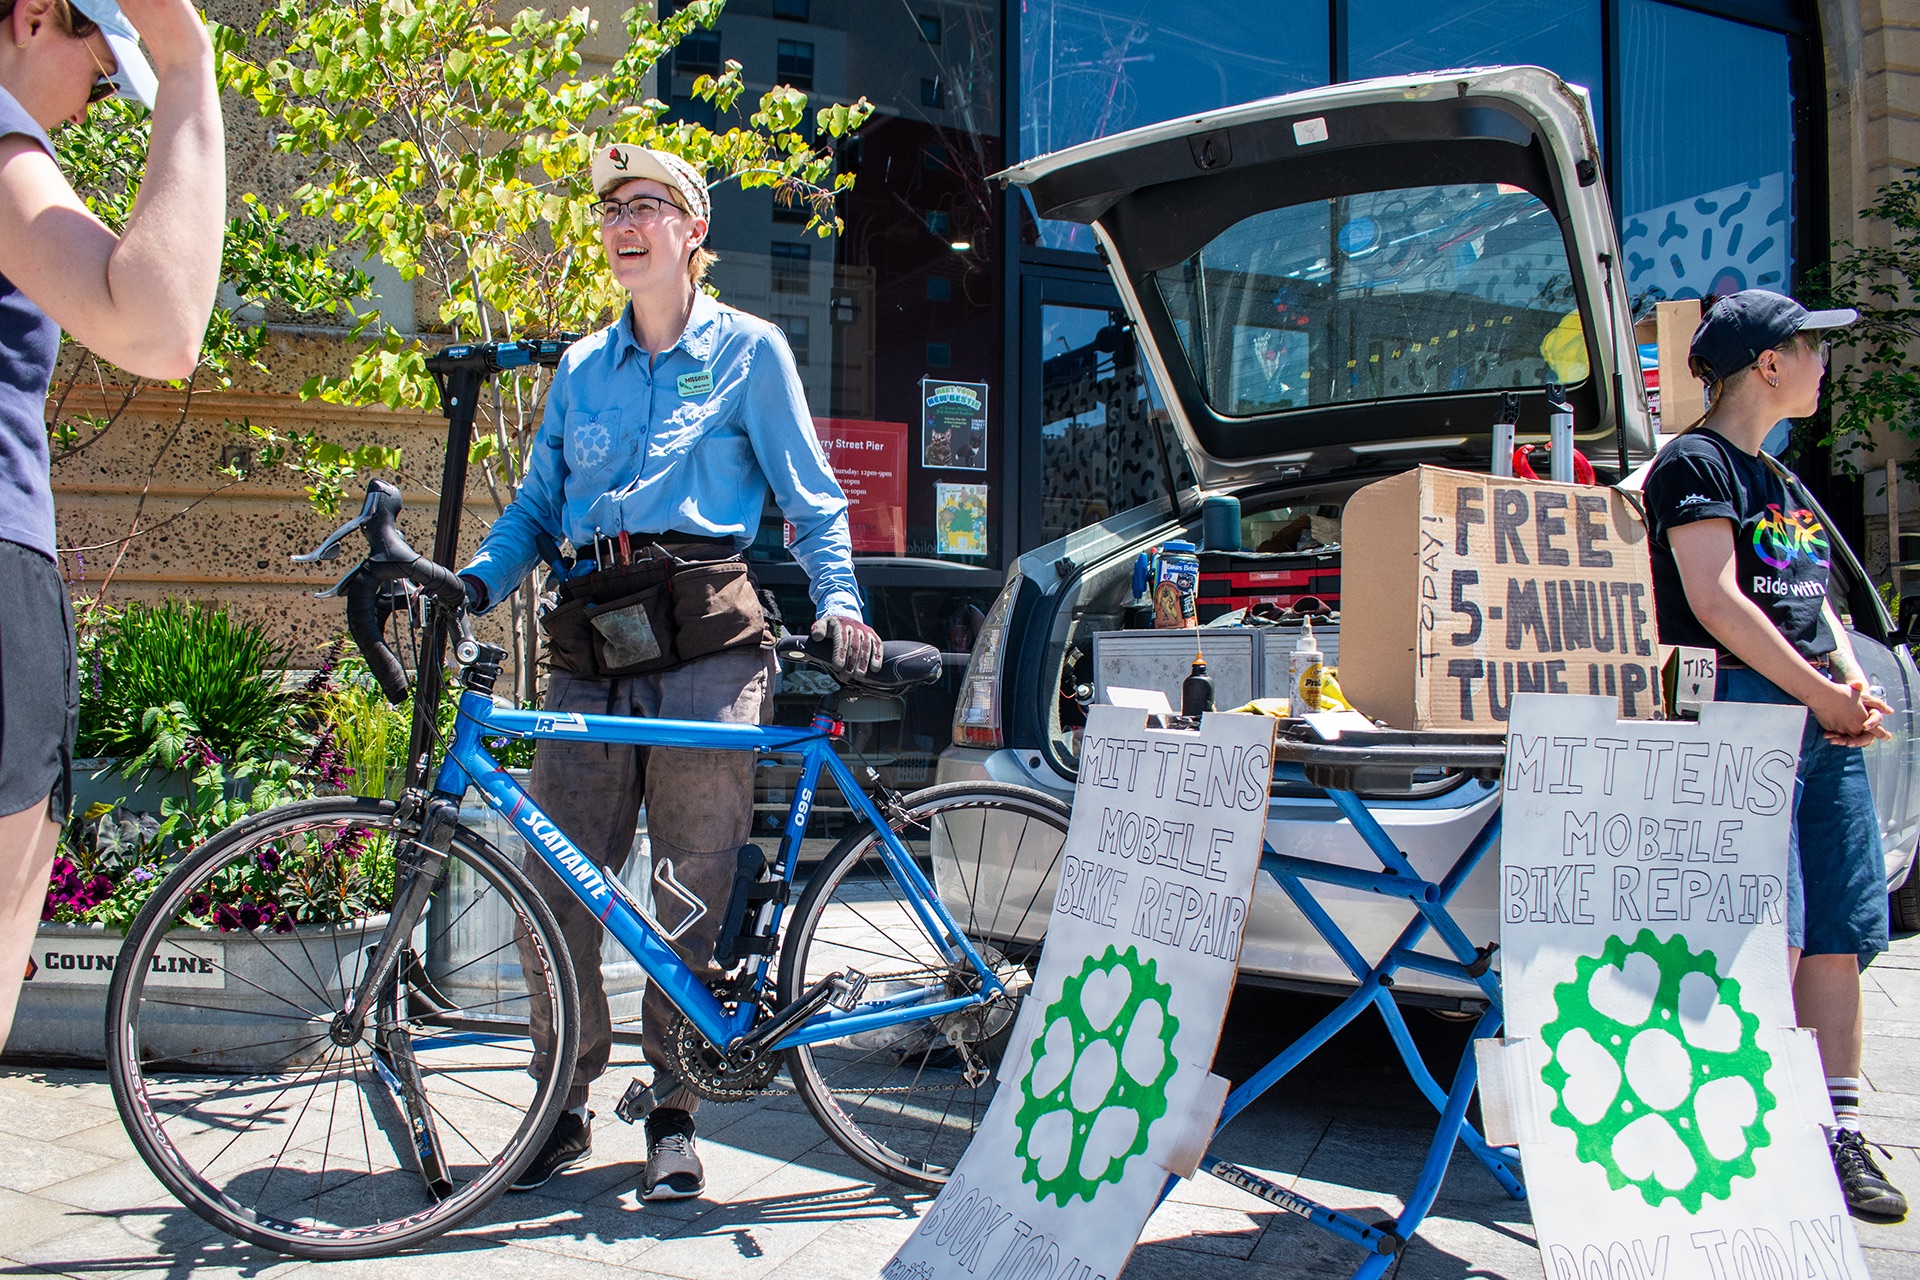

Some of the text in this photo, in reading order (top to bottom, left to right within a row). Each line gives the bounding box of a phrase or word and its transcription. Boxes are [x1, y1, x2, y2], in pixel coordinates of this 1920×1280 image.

[927, 394, 981, 409] NEW BESTIE
[935, 386, 976, 398] MEET YOUR
[821, 439, 884, 451] rry Street Pier
[833, 467, 859, 476] hursday:
[1455, 486, 1614, 568] FREE
[1419, 516, 1444, 678] TODAY!
[1450, 569, 1651, 657] 5-MINUTE
[1753, 575, 1788, 596] Ride
[1789, 579, 1827, 597] with
[1683, 659, 1715, 679] TIPS
[794, 787, 813, 827] 560
[1078, 735, 1270, 811] MITTENS
[1506, 733, 1795, 816] MITTENS
[521, 810, 612, 900] SCATTANTE
[1098, 807, 1235, 883] MOBILE
[1562, 810, 1743, 864] MOBILE
[1056, 854, 1247, 962] BIKE REPAIR
[1504, 864, 1783, 925] BIKE REPAIR
[920, 1173, 1013, 1275] BOOK
